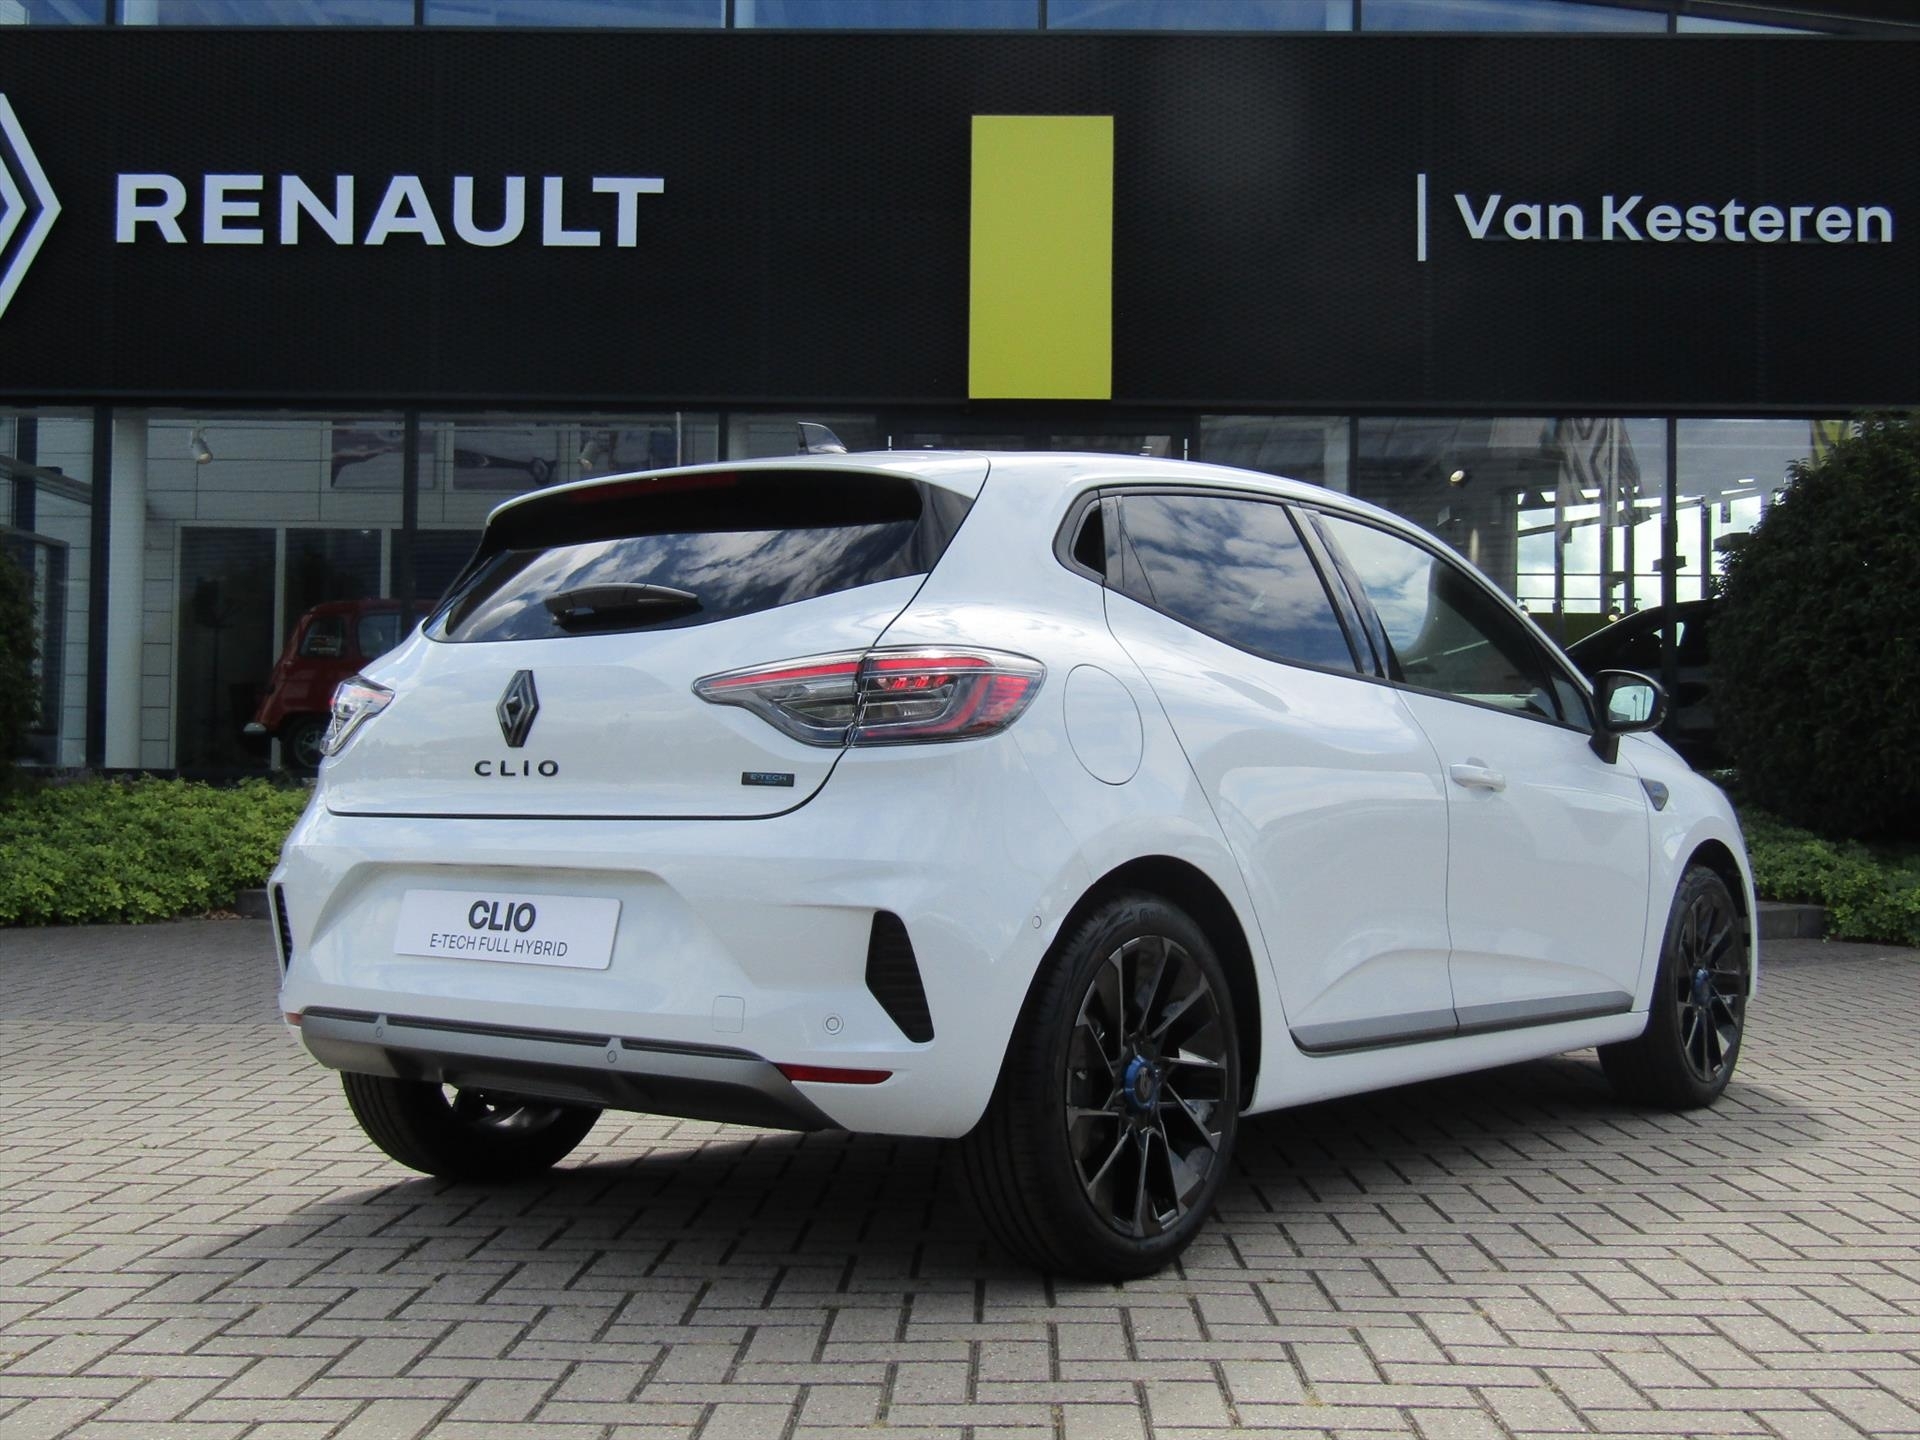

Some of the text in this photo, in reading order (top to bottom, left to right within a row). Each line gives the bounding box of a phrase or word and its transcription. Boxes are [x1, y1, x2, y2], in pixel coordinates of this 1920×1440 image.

[116, 173, 665, 248] RENAULT
[1454, 194, 1893, 243] Van Kesteren
[474, 759, 559, 777] CLIO
[468, 900, 537, 933] CLIO
[429, 933, 568, 957] E-TECH FULL HYBRID
